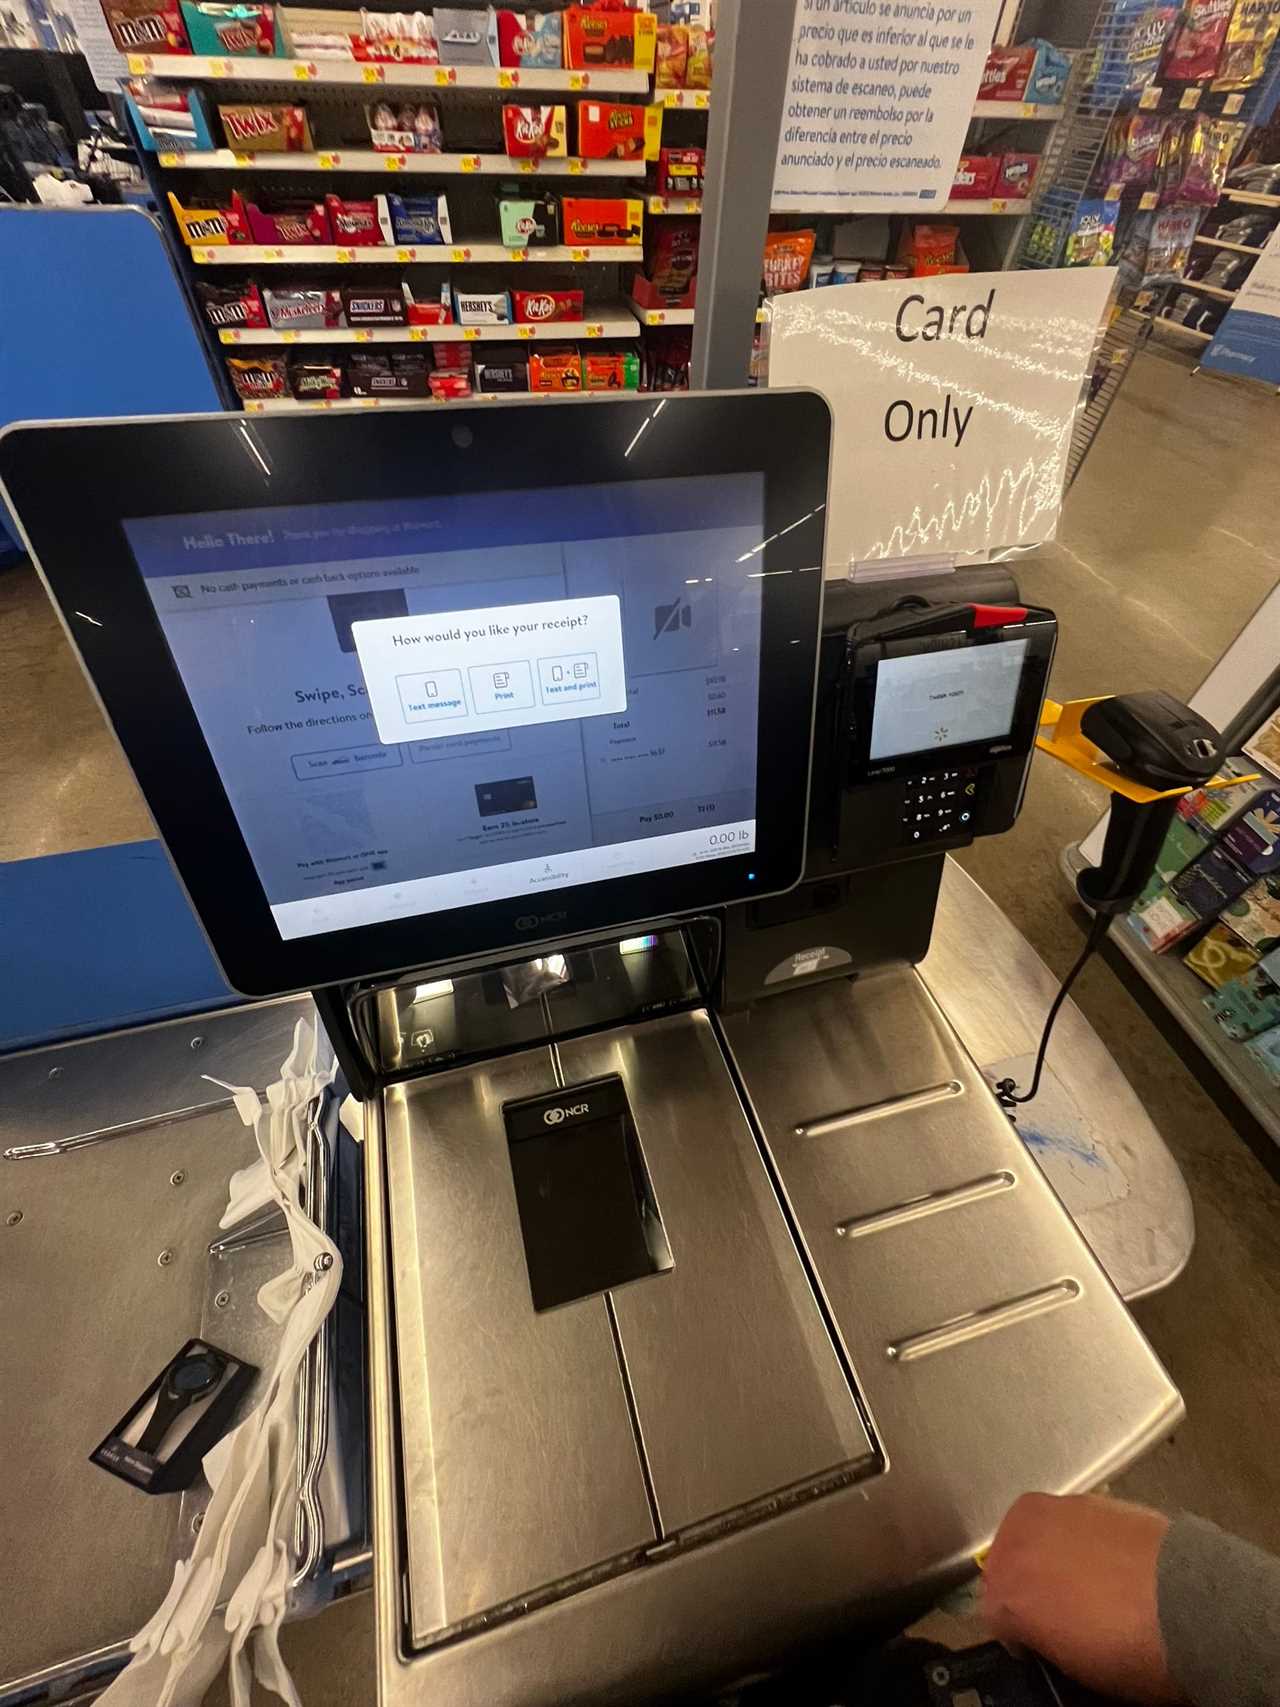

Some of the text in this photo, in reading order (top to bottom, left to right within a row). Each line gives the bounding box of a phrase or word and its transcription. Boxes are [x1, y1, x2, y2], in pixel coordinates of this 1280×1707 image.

[879, 3, 891, 17] se
[894, 2, 936, 21] anuncia
[936, 7, 956, 26] por
[958, 9, 972, 23] un
[798, 22, 976, 52] precio que es inferior al que se le
[795, 50, 960, 77] ha cobrado a usted por nuestro
[791, 75, 932, 101] sistema de escaneo, puede
[788, 103, 934, 127] obtener un reembolso por la
[784, 126, 913, 149] diferencia entre el precio
[781, 150, 943, 172] anunciado y el precio escaneado.
[350, 299, 385, 314] SNICKERS
[895, 288, 997, 343] Card
[884, 395, 974, 448] Only
[183, 529, 275, 551] Hello There!
[200, 565, 421, 593] No cash payments or cash back options available
[393, 614, 589, 648] How would you like your receipt?
[295, 688, 345, 704] Swipe,
[495, 691, 514, 701] Print
[545, 680, 597, 695] Text and print
[408, 698, 462, 712] Text message
[246, 722, 283, 735] Follow
[284, 720, 303, 731] the
[305, 712, 357, 728] directions
[709, 829, 750, 846] 0.00 lb
[565, 1103, 590, 1118] NCR
